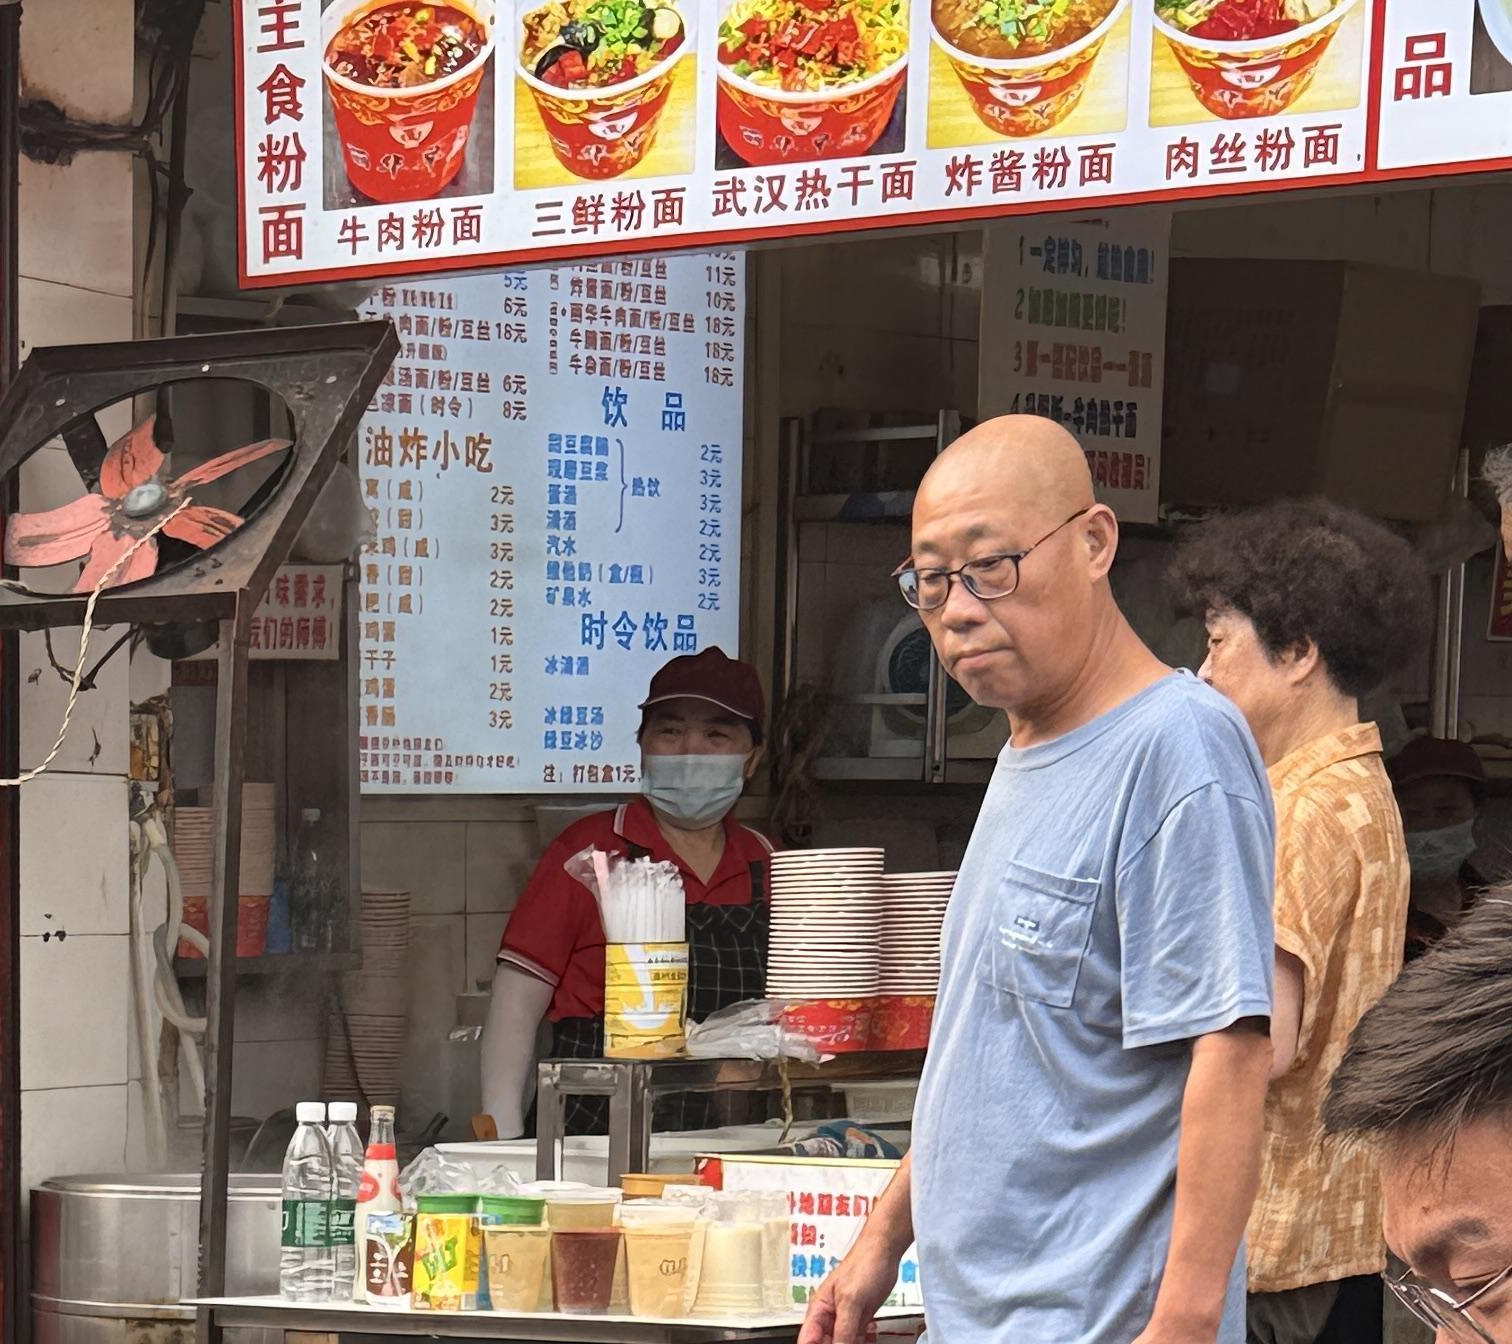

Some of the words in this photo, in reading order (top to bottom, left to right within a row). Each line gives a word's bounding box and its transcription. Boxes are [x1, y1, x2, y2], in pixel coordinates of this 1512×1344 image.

[1393, 32, 1453, 101] 品
[256, 0, 308, 265] 主食粉面
[1165, 123, 1343, 181] 肉丝粉面
[944, 143, 1116, 197] 炸酱粉面
[712, 159, 919, 218] 武汉热干面
[531, 186, 688, 238] 三鲜粉面
[336, 204, 485, 256] 牛肉粉面
[504, 296, 528, 317] 6元
[502, 374, 528, 395] 6元
[502, 400, 528, 421] 8元
[601, 385, 686, 432] 饮品
[366, 425, 494, 473] 油炸小吃
[700, 444, 723, 464] 2元
[700, 469, 723, 488] 3元
[490, 485, 514, 506] 2元
[700, 494, 722, 514] 3元
[490, 513, 514, 534] 3元
[699, 518, 722, 538] 2元
[490, 542, 514, 562] 3元
[699, 543, 722, 563] 2元
[489, 570, 514, 591] 2元
[698, 567, 721, 588] 3元
[489, 598, 514, 618] 2元
[697, 592, 721, 612] 2元
[491, 626, 514, 646] 1元
[581, 610, 697, 652] 时令饮品
[490, 654, 513, 674] 1元
[489, 682, 513, 702] 2元
[489, 710, 513, 730] 3元
